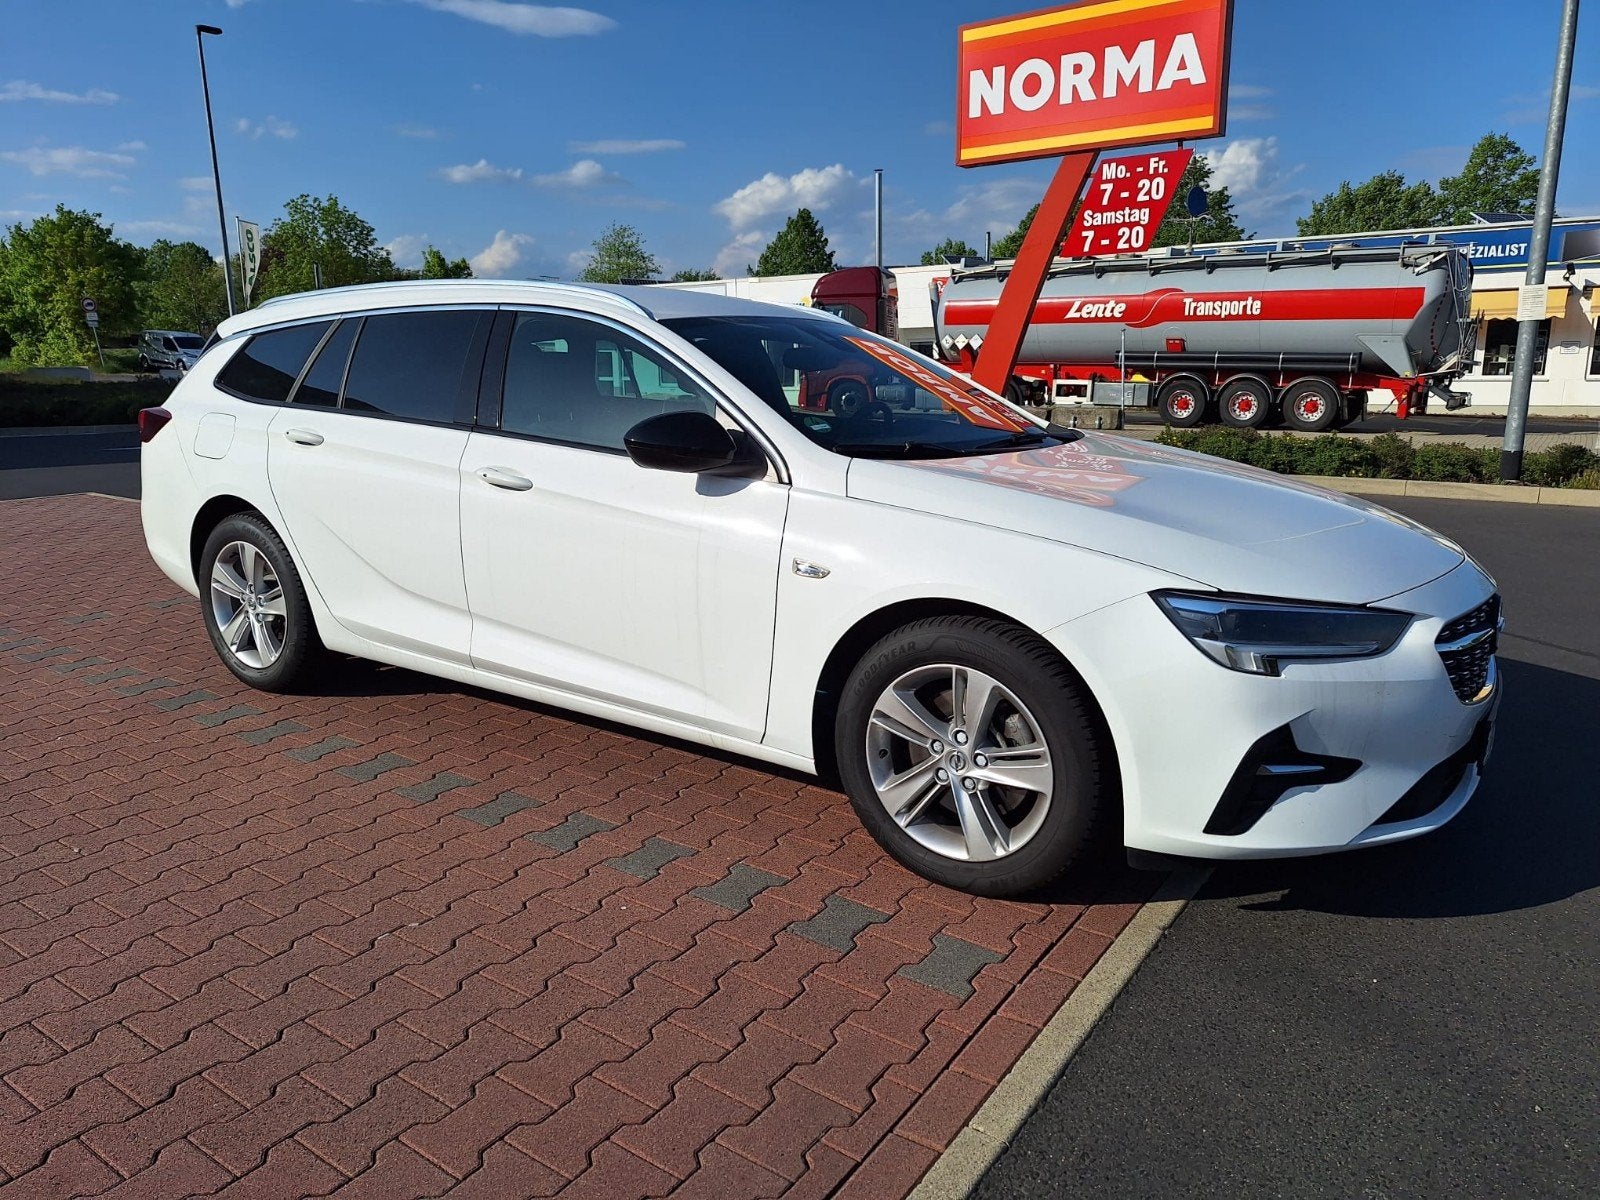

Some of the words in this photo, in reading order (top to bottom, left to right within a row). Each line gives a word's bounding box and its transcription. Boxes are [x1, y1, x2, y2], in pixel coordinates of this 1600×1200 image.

[968, 32, 1207, 119] NORMA
[1102, 162, 1131, 180] Mo.
[1149, 157, 1168, 175] Fr.
[1100, 182, 1114, 206] 7
[1136, 177, 1165, 202] 20
[1083, 207, 1150, 227] Samstag
[1081, 230, 1095, 252] 7
[1116, 226, 1145, 250] 20
[1064, 300, 1127, 319] Lente
[1183, 296, 1262, 318] Transporte
[854, 641, 917, 696] GOODYEAR
